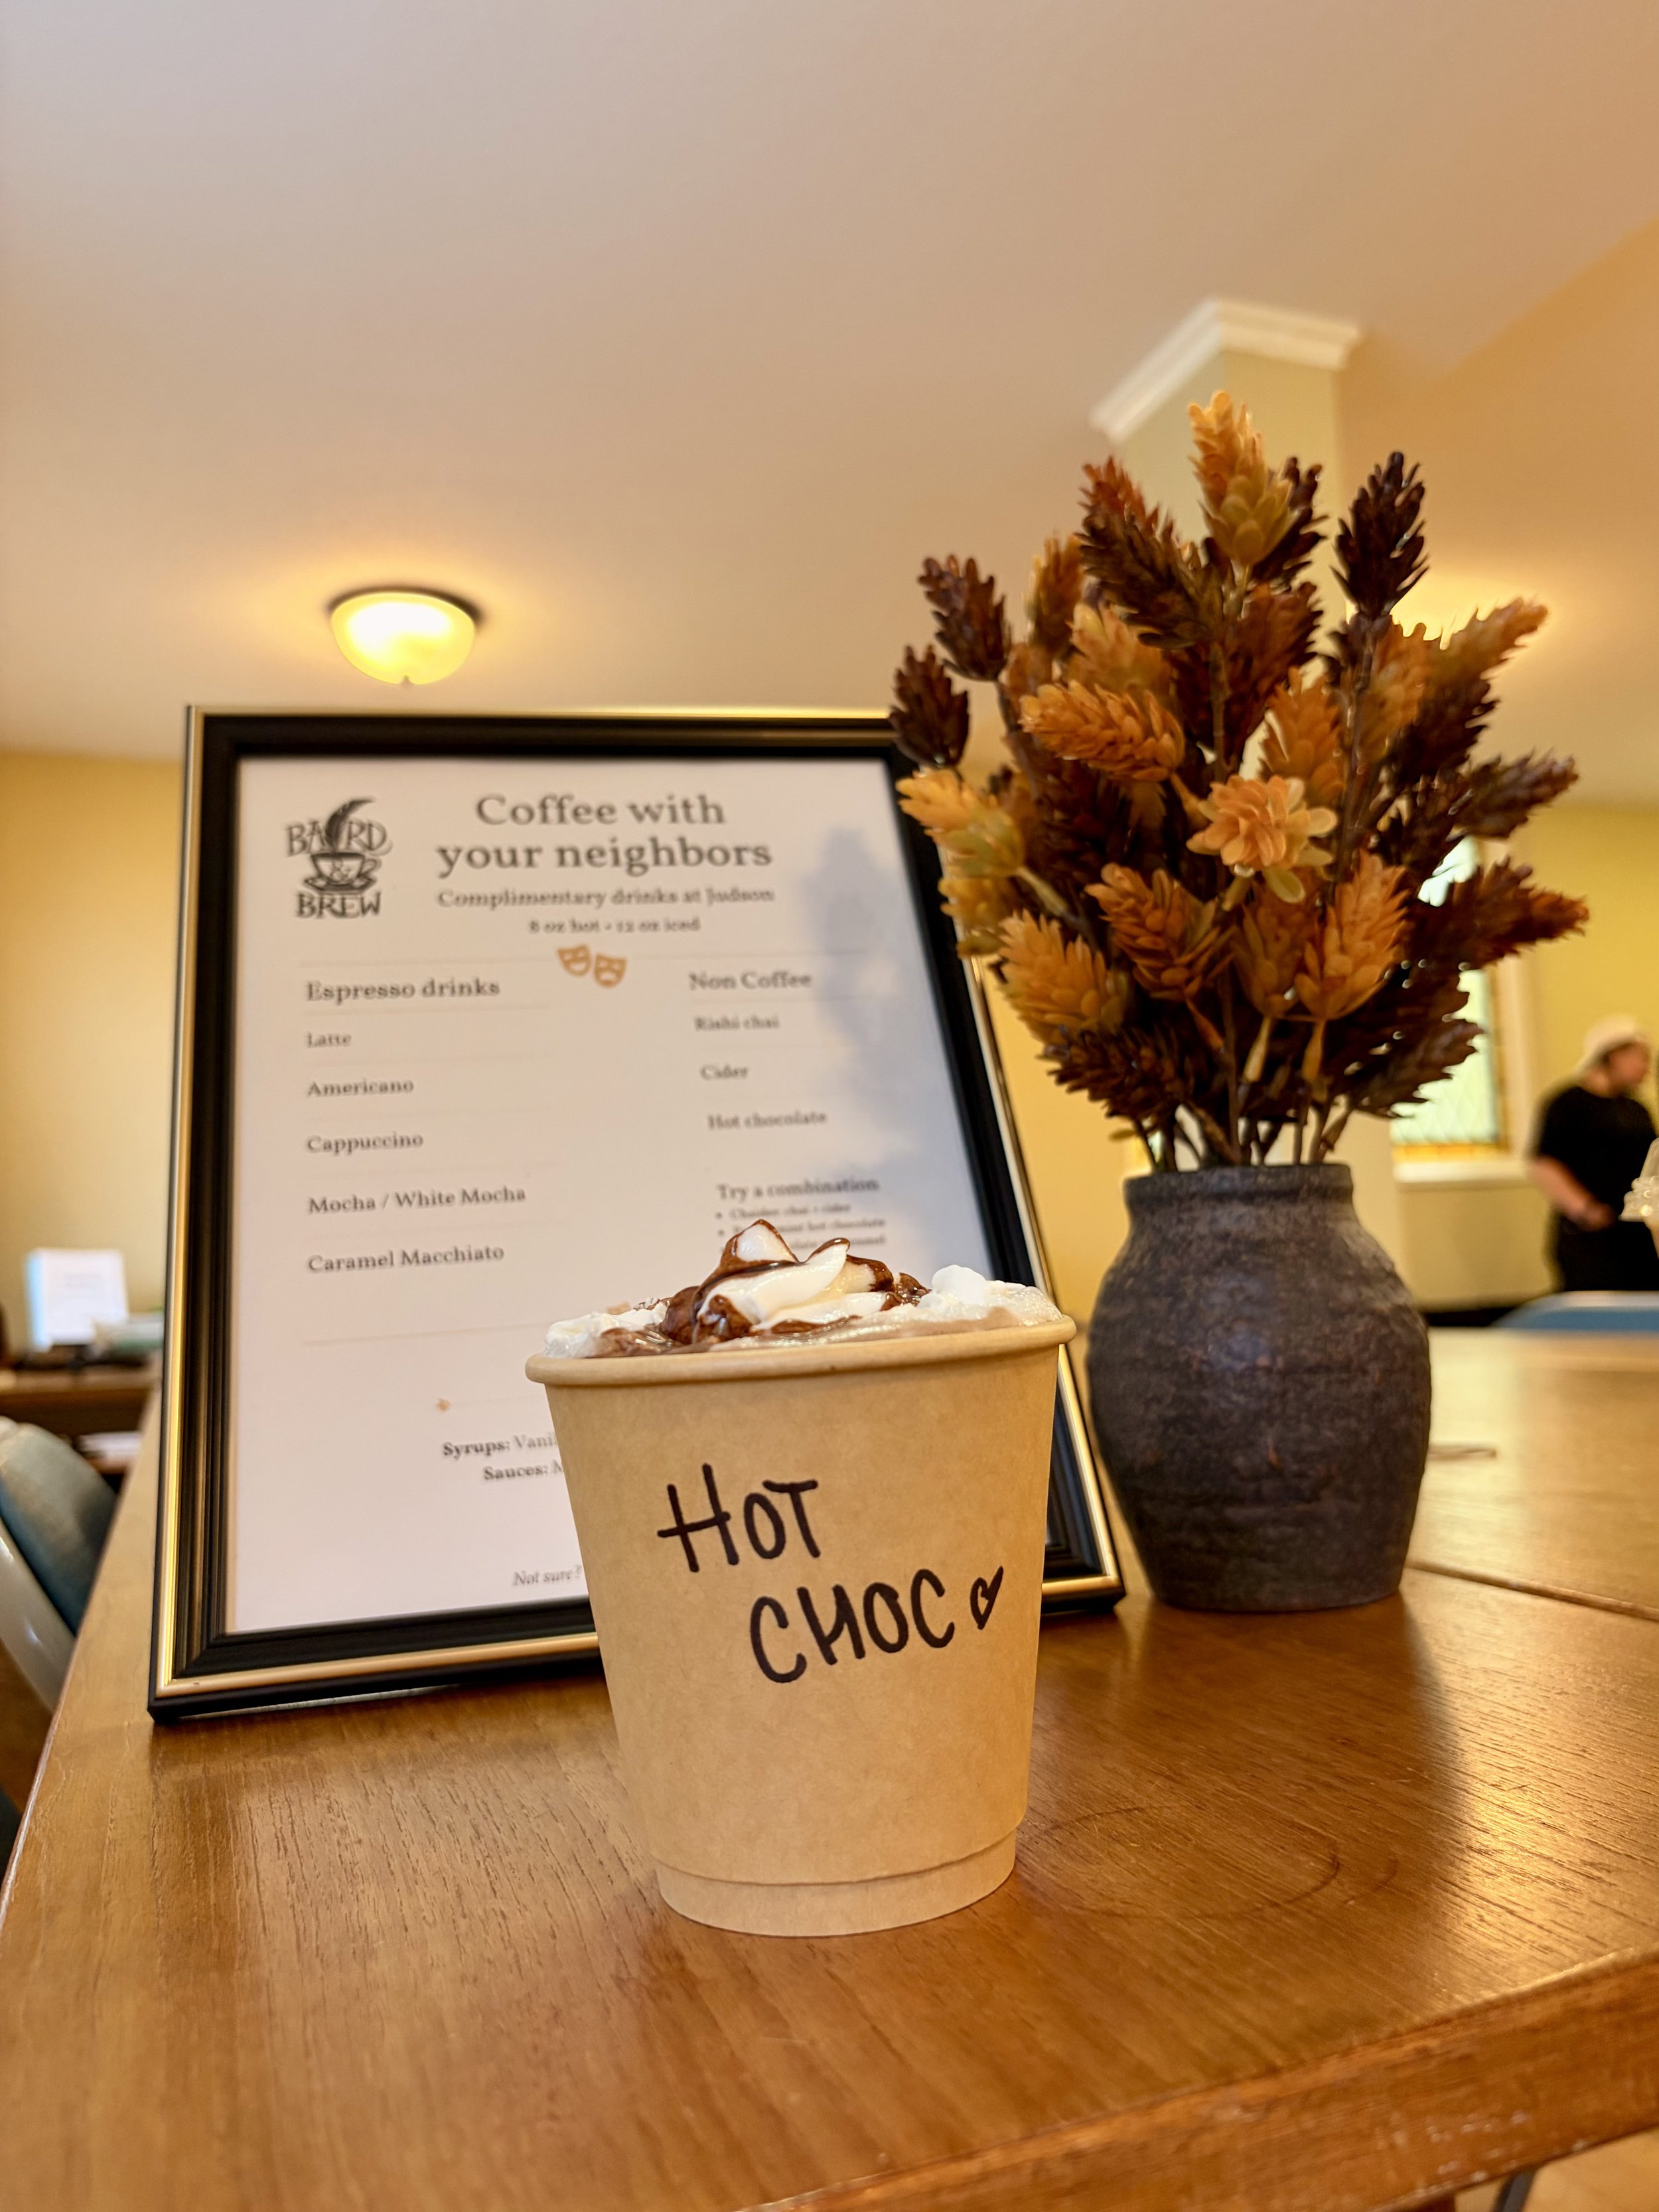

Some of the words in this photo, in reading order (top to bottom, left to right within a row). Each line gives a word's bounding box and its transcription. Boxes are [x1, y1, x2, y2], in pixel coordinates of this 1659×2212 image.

[476, 795, 617, 825] Coffee
[628, 794, 725, 824] with
[437, 846, 542, 879] your
[556, 836, 772, 877] neighbors
[298, 891, 381, 919] BREW
[437, 889, 607, 911] Complimentary
[611, 887, 678, 905] drinks
[682, 889, 701, 904] at
[705, 886, 775, 907] Judson
[529, 920, 540, 932] 8
[544, 922, 564, 932] oz
[570, 919, 599, 932] hot
[638, 921, 659, 932] oz
[664, 916, 700, 931] iced
[307, 980, 415, 1005] Espresso
[421, 976, 500, 997] drinks
[689, 971, 737, 990] Non
[741, 970, 812, 990] Coffee
[743, 1013, 779, 1029] chai
[307, 1031, 352, 1048] Latte
[699, 1064, 748, 1080] Cider
[307, 1078, 414, 1098] Americano
[707, 1114, 741, 1130] Hot
[745, 1109, 827, 1129] chocolate
[307, 1132, 423, 1157] Cappuccino
[308, 1195, 376, 1215] Mocha
[394, 1189, 455, 1209] White
[461, 1186, 526, 1205] Mocha
[717, 1184, 747, 1201] Try
[753, 1185, 763, 1197] a
[766, 1178, 880, 1196] combination
[308, 1251, 395, 1274] Caramel
[401, 1246, 504, 1267] Macchiato
[443, 1439, 510, 1460] Syrups:
[483, 1464, 549, 1481] Sauces:
[657, 1463, 821, 1573] HOT
[512, 1572, 540, 1586] Not
[543, 1565, 581, 1583] sure?
[750, 1568, 955, 1684] CHOC
